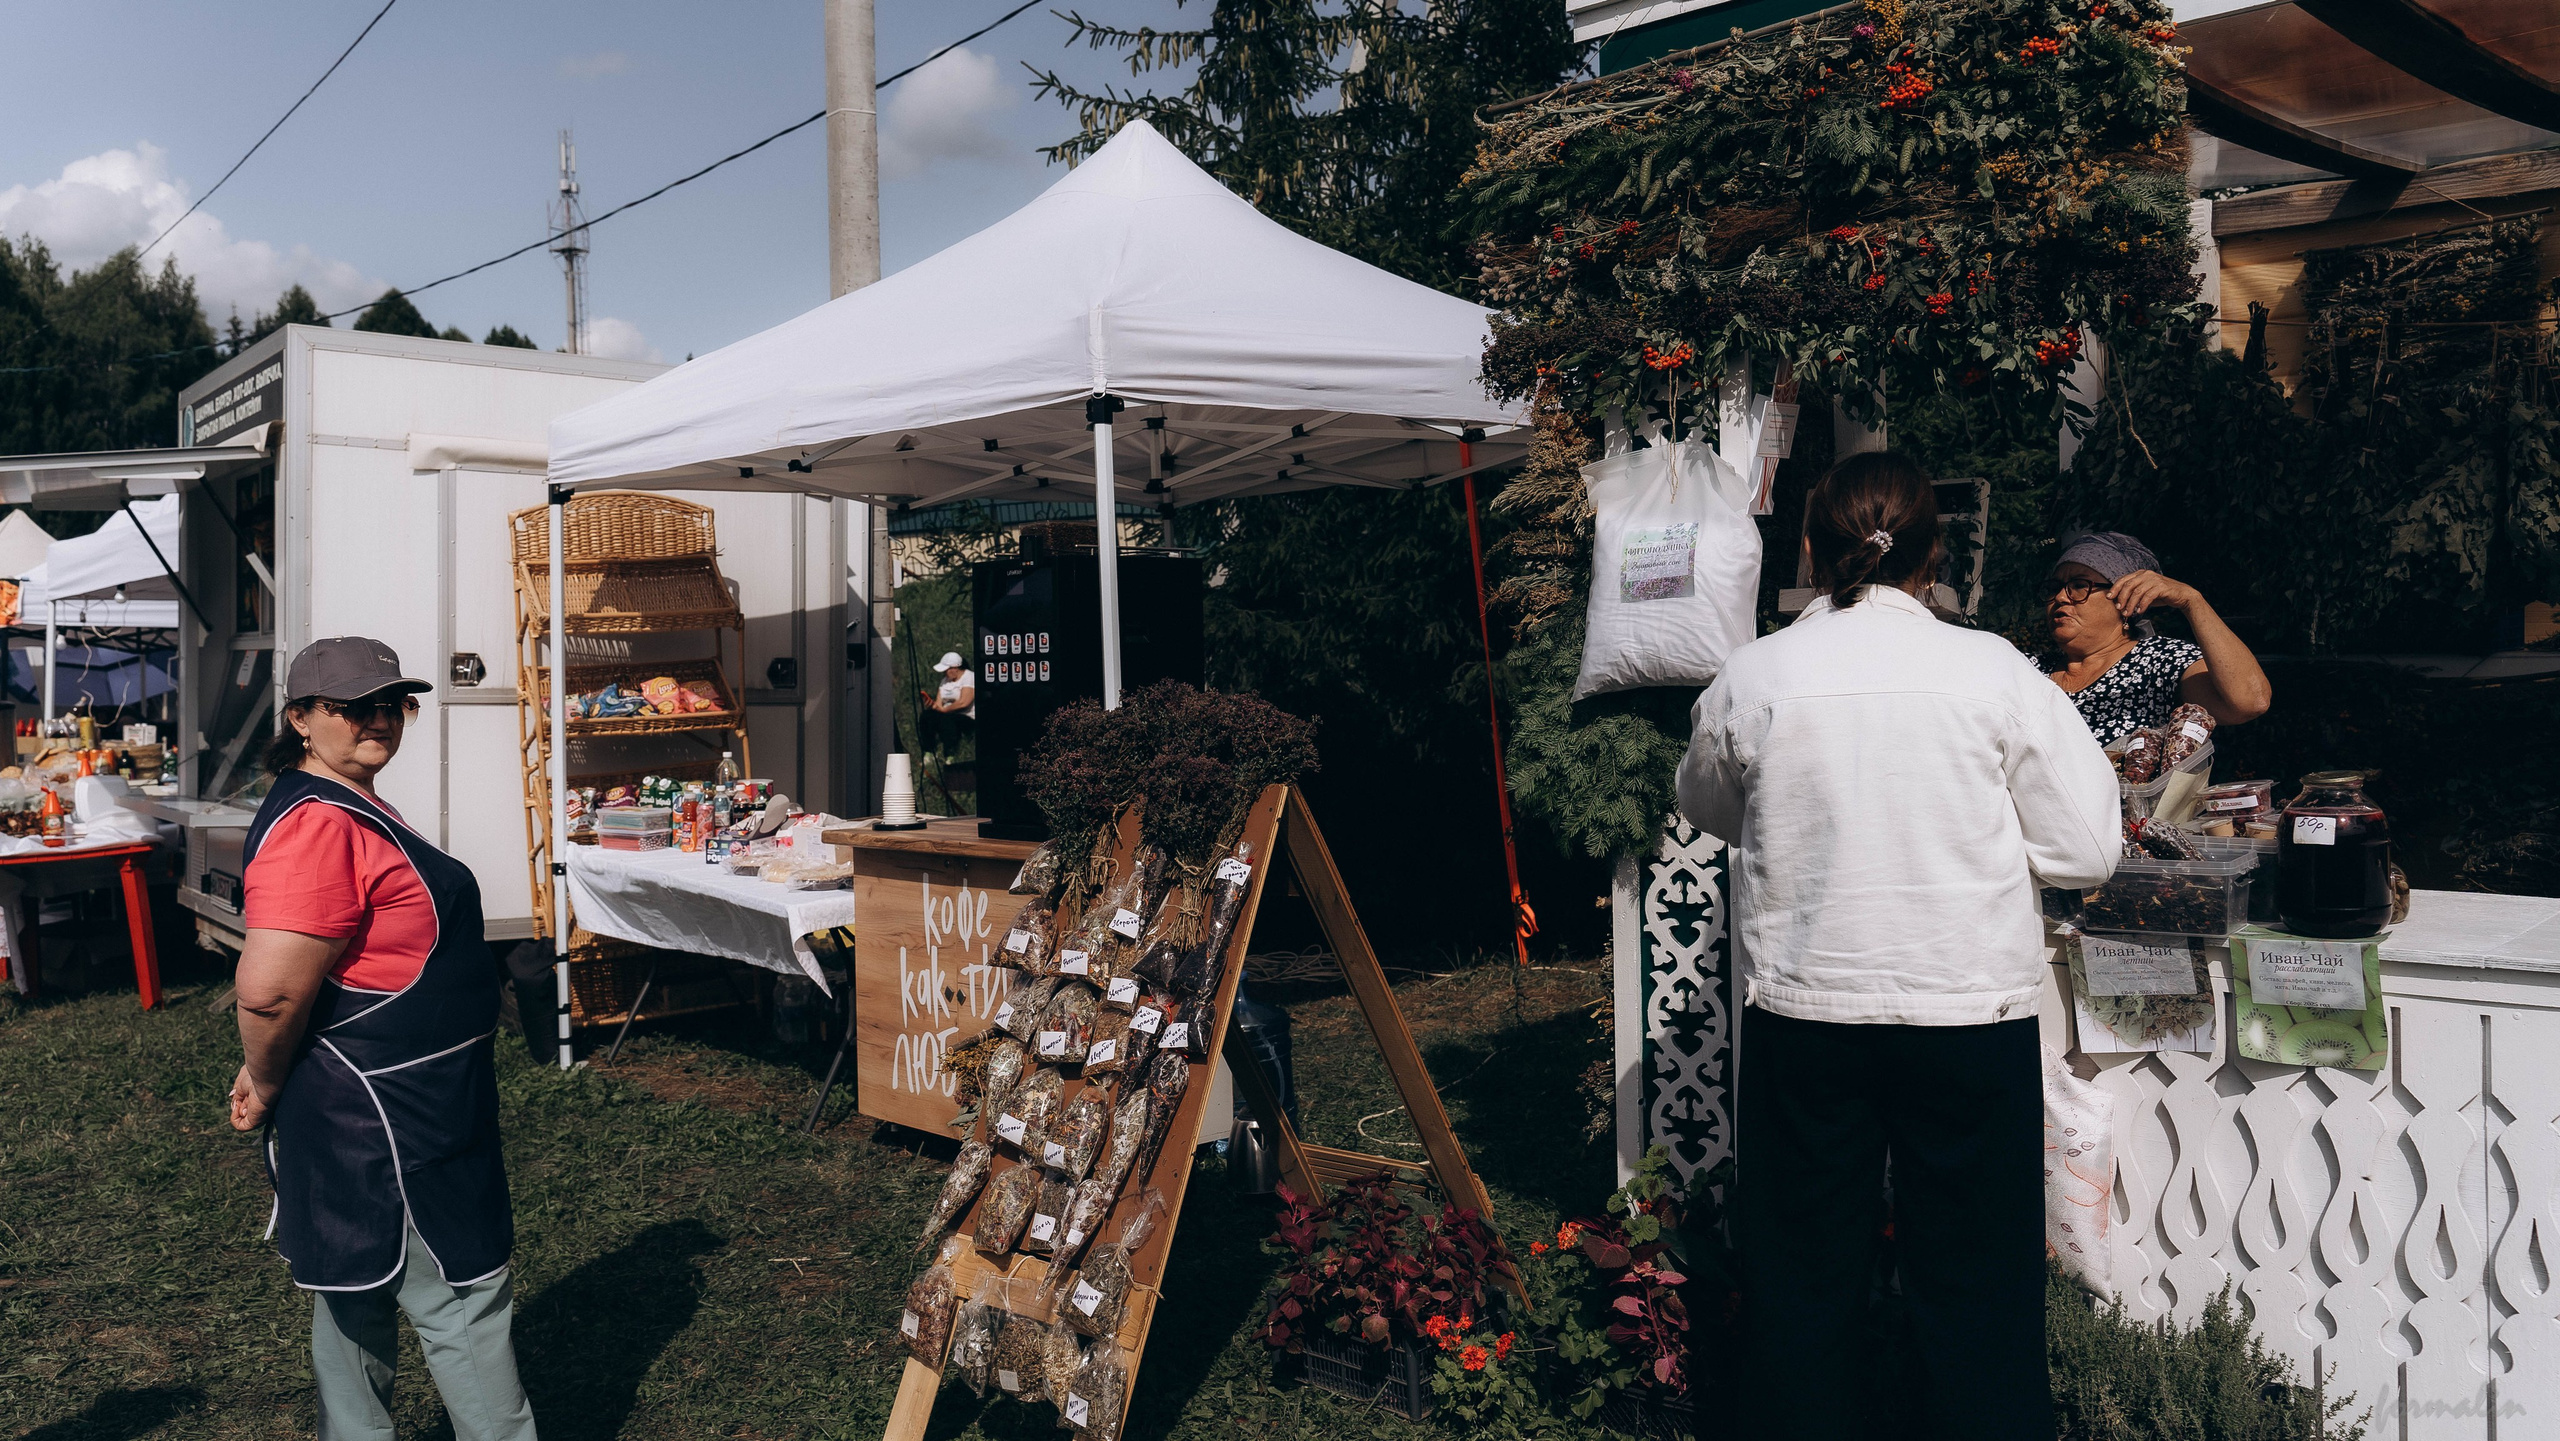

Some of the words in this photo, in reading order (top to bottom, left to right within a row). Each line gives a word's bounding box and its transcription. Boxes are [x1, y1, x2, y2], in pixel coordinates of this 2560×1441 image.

[2220, 800, 2243, 808] Малина
[2297, 817, 2328, 834] 50р.
[922, 872, 993, 956] кофе
[2094, 945, 2173, 957] Иван-Чай
[2260, 952, 2344, 967] Иван-Чай
[900, 945, 951, 1029] как
